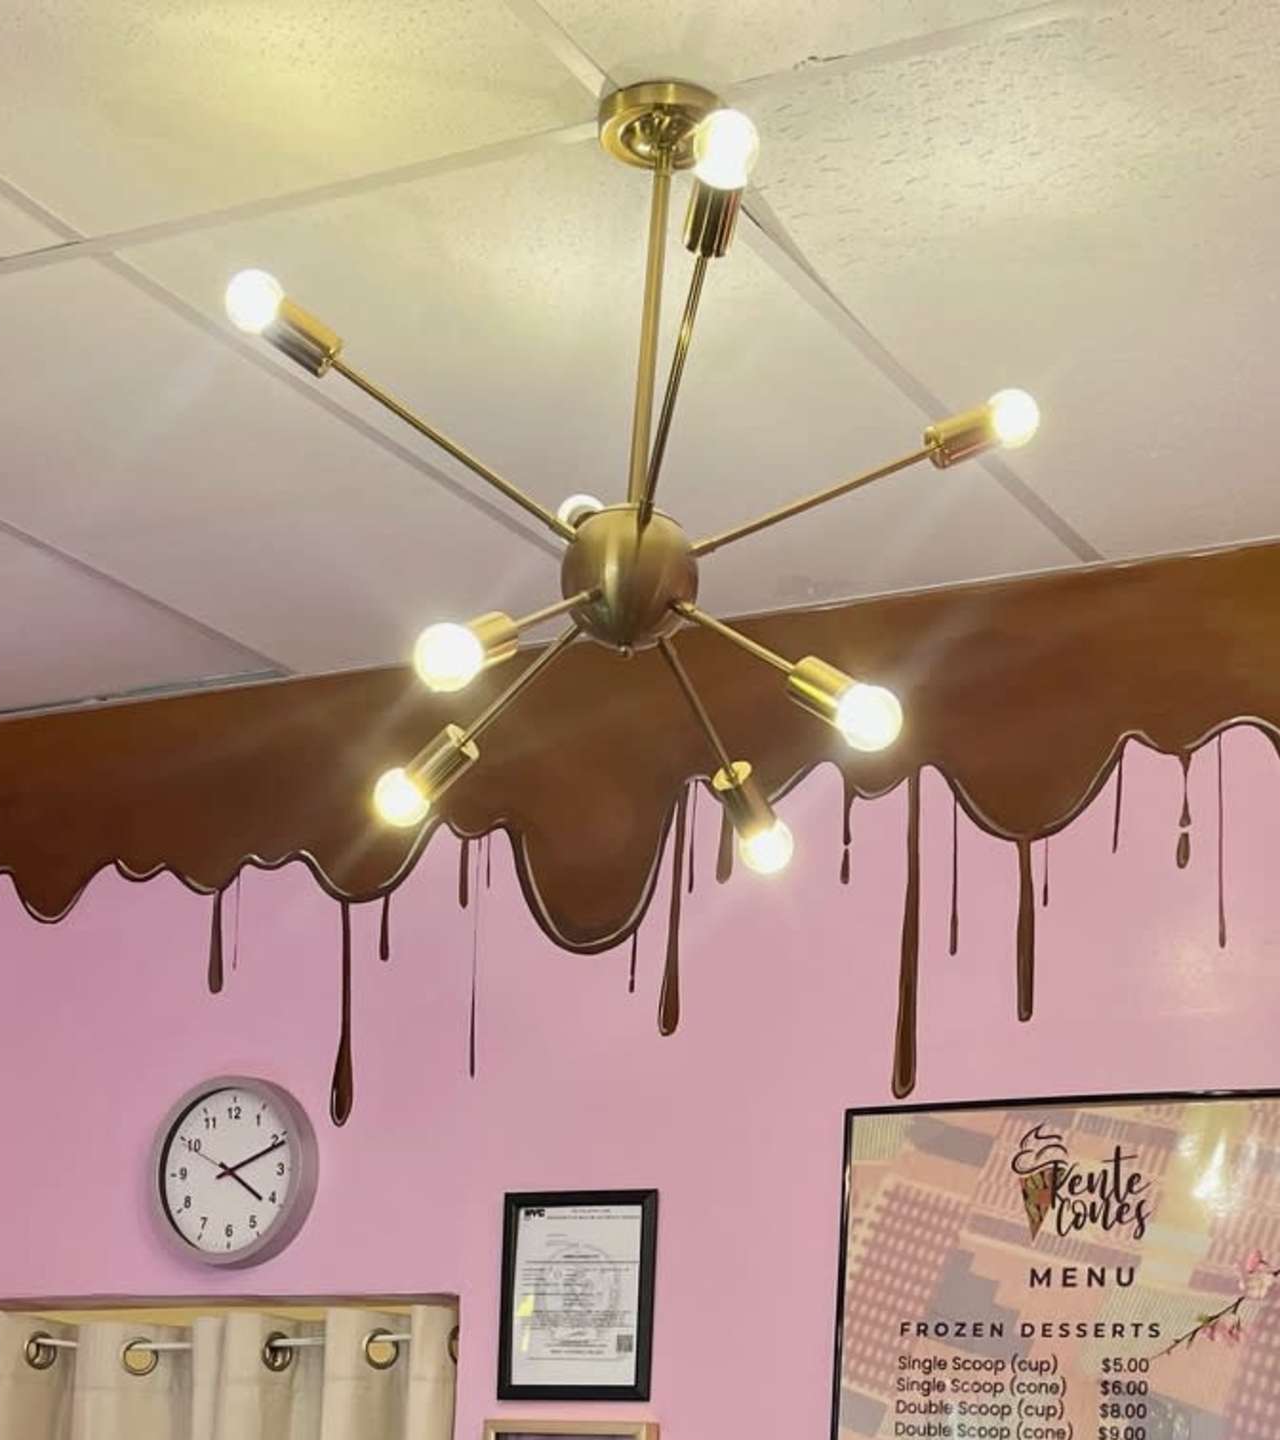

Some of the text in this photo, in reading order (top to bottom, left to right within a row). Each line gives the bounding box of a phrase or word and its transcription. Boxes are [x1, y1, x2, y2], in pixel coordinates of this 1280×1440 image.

[227, 1107, 242, 1120] 12
[204, 1117, 217, 1129] 11
[187, 1138, 202, 1153] 10
[179, 1168, 188, 1181] 9
[276, 1162, 285, 1176] 3
[183, 1196, 192, 1209] 8
[269, 1191, 278, 1204] 4
[200, 1217, 209, 1230] 7
[249, 1215, 258, 1229] 5
[225, 1224, 234, 1237] 6
[1029, 1267, 1136, 1288] MENU
[899, 1322, 1162, 1339] FROZEN DESSERTS
[897, 1356, 1150, 1375] Single Scoop (cup) $5.00
[897, 1378, 1149, 1397] Single Scoop (cone) $6.00
[895, 1401, 1148, 1420] Double Scoop (cup) $8.00
[894, 1423, 951, 1439] Double
